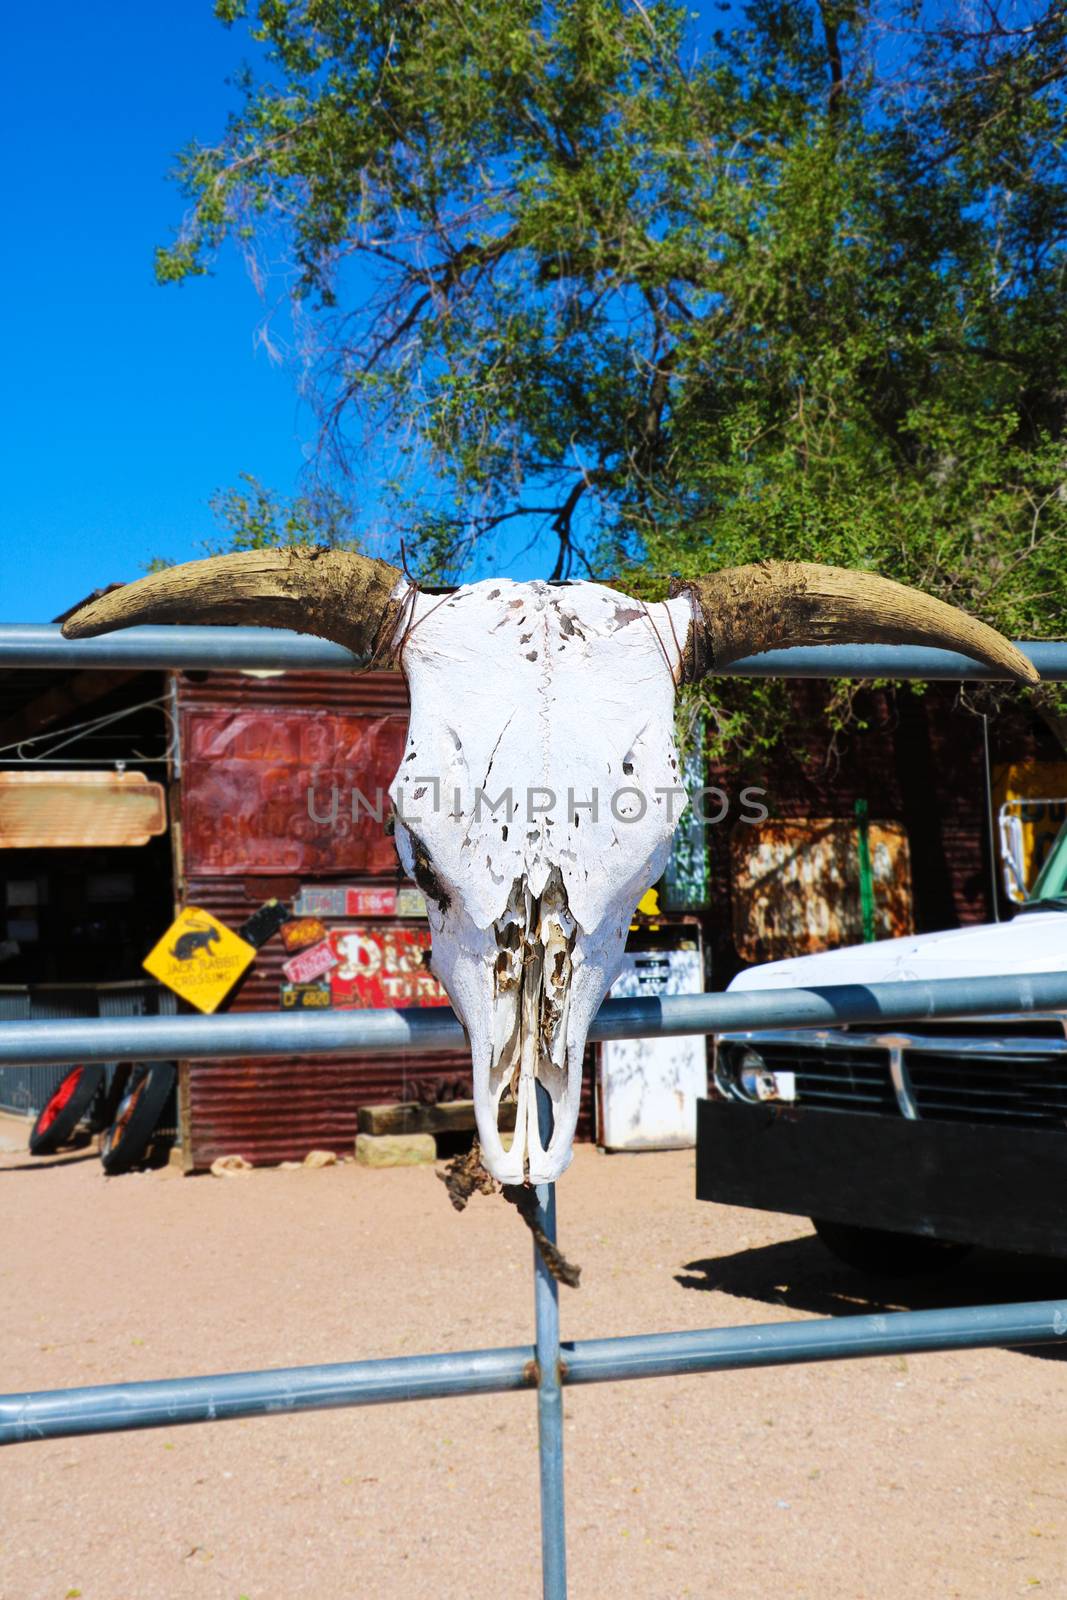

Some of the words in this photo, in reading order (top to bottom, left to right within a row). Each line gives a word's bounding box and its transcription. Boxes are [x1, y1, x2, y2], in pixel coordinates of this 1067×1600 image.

[166, 961, 195, 976] JACK
[199, 954, 241, 972] RABBIT
[174, 971, 231, 987] CROSSING
